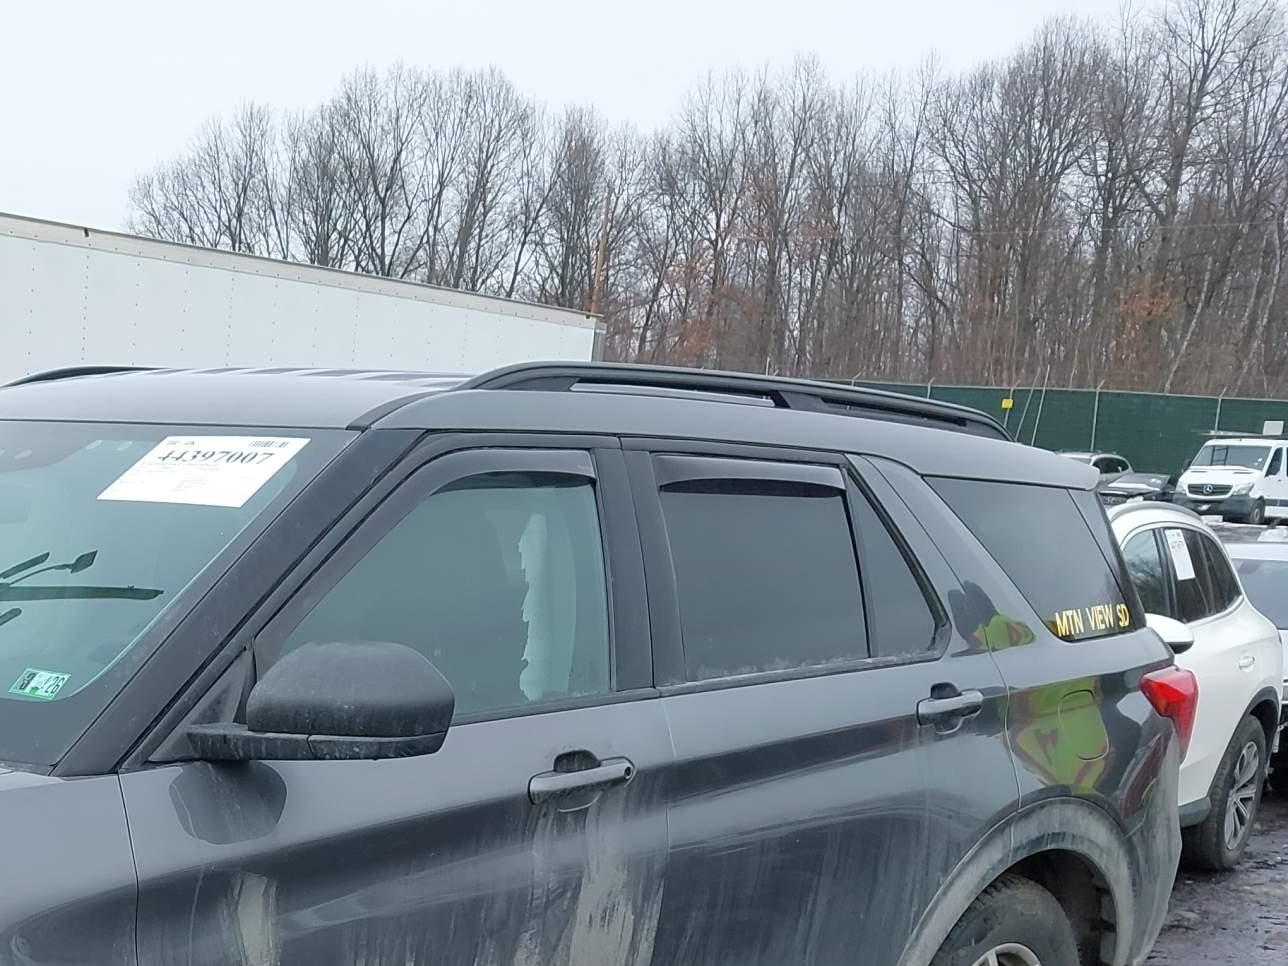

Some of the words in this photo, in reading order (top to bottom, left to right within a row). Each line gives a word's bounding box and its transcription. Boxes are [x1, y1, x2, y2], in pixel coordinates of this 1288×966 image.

[156, 450, 275, 465] 44397007
[1055, 608, 1085, 637] MTN
[1085, 603, 1114, 631] VIEW
[1115, 603, 1130, 628] SD
